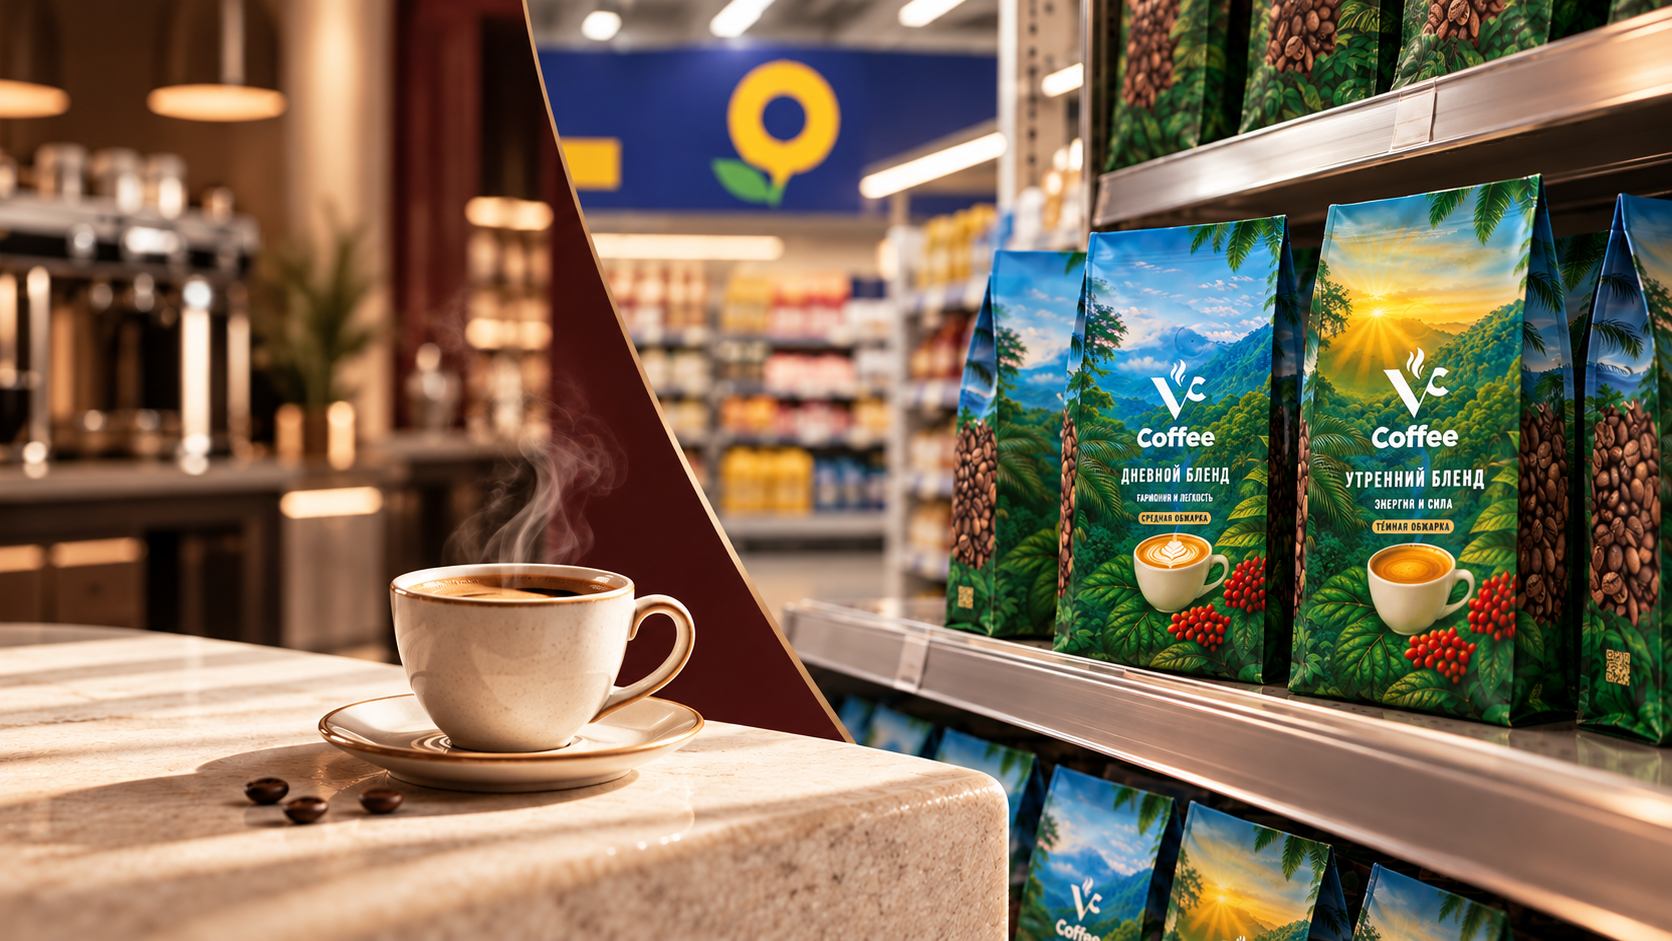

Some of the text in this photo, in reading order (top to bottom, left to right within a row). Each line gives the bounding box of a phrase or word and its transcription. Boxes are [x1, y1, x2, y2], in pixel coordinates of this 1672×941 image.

[1136, 427, 1216, 448] Coffee
[1371, 425, 1459, 449] Coffee
[1121, 464, 1230, 485] ДНЕВНОЙ БЛЕНД
[1345, 467, 1485, 489] УТРЕННИЙ БЛЕНД
[1374, 499, 1453, 510] ЭНЕРГИЯ И СИЛА
[1174, 514, 1209, 523] ОБЖАРКА
[1411, 522, 1450, 532] ОБЖАРКА
